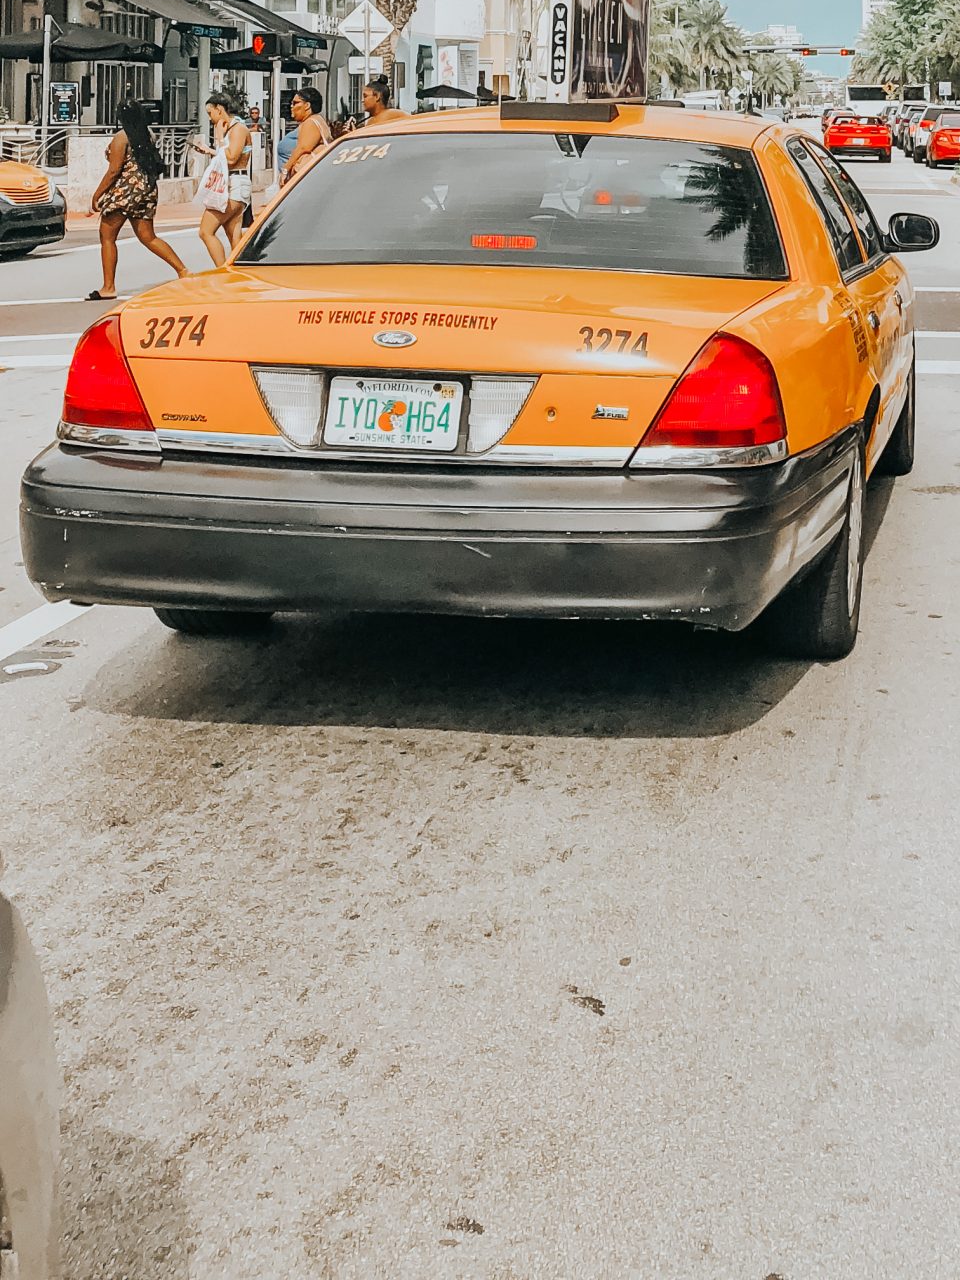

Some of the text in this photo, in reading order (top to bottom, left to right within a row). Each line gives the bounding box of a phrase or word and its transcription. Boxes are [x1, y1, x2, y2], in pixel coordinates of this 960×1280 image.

[553, 7, 567, 83] VACANT
[332, 143, 391, 165] 3274
[139, 315, 209, 349] 3274
[298, 310, 498, 331] THIS VEHICLE STOPS FREQUENTLY
[381, 332, 408, 346] Ford
[576, 326, 649, 358] 3274
[405, 401, 451, 433] H64
[355, 432, 427, 445] SUNSHINE STATE
